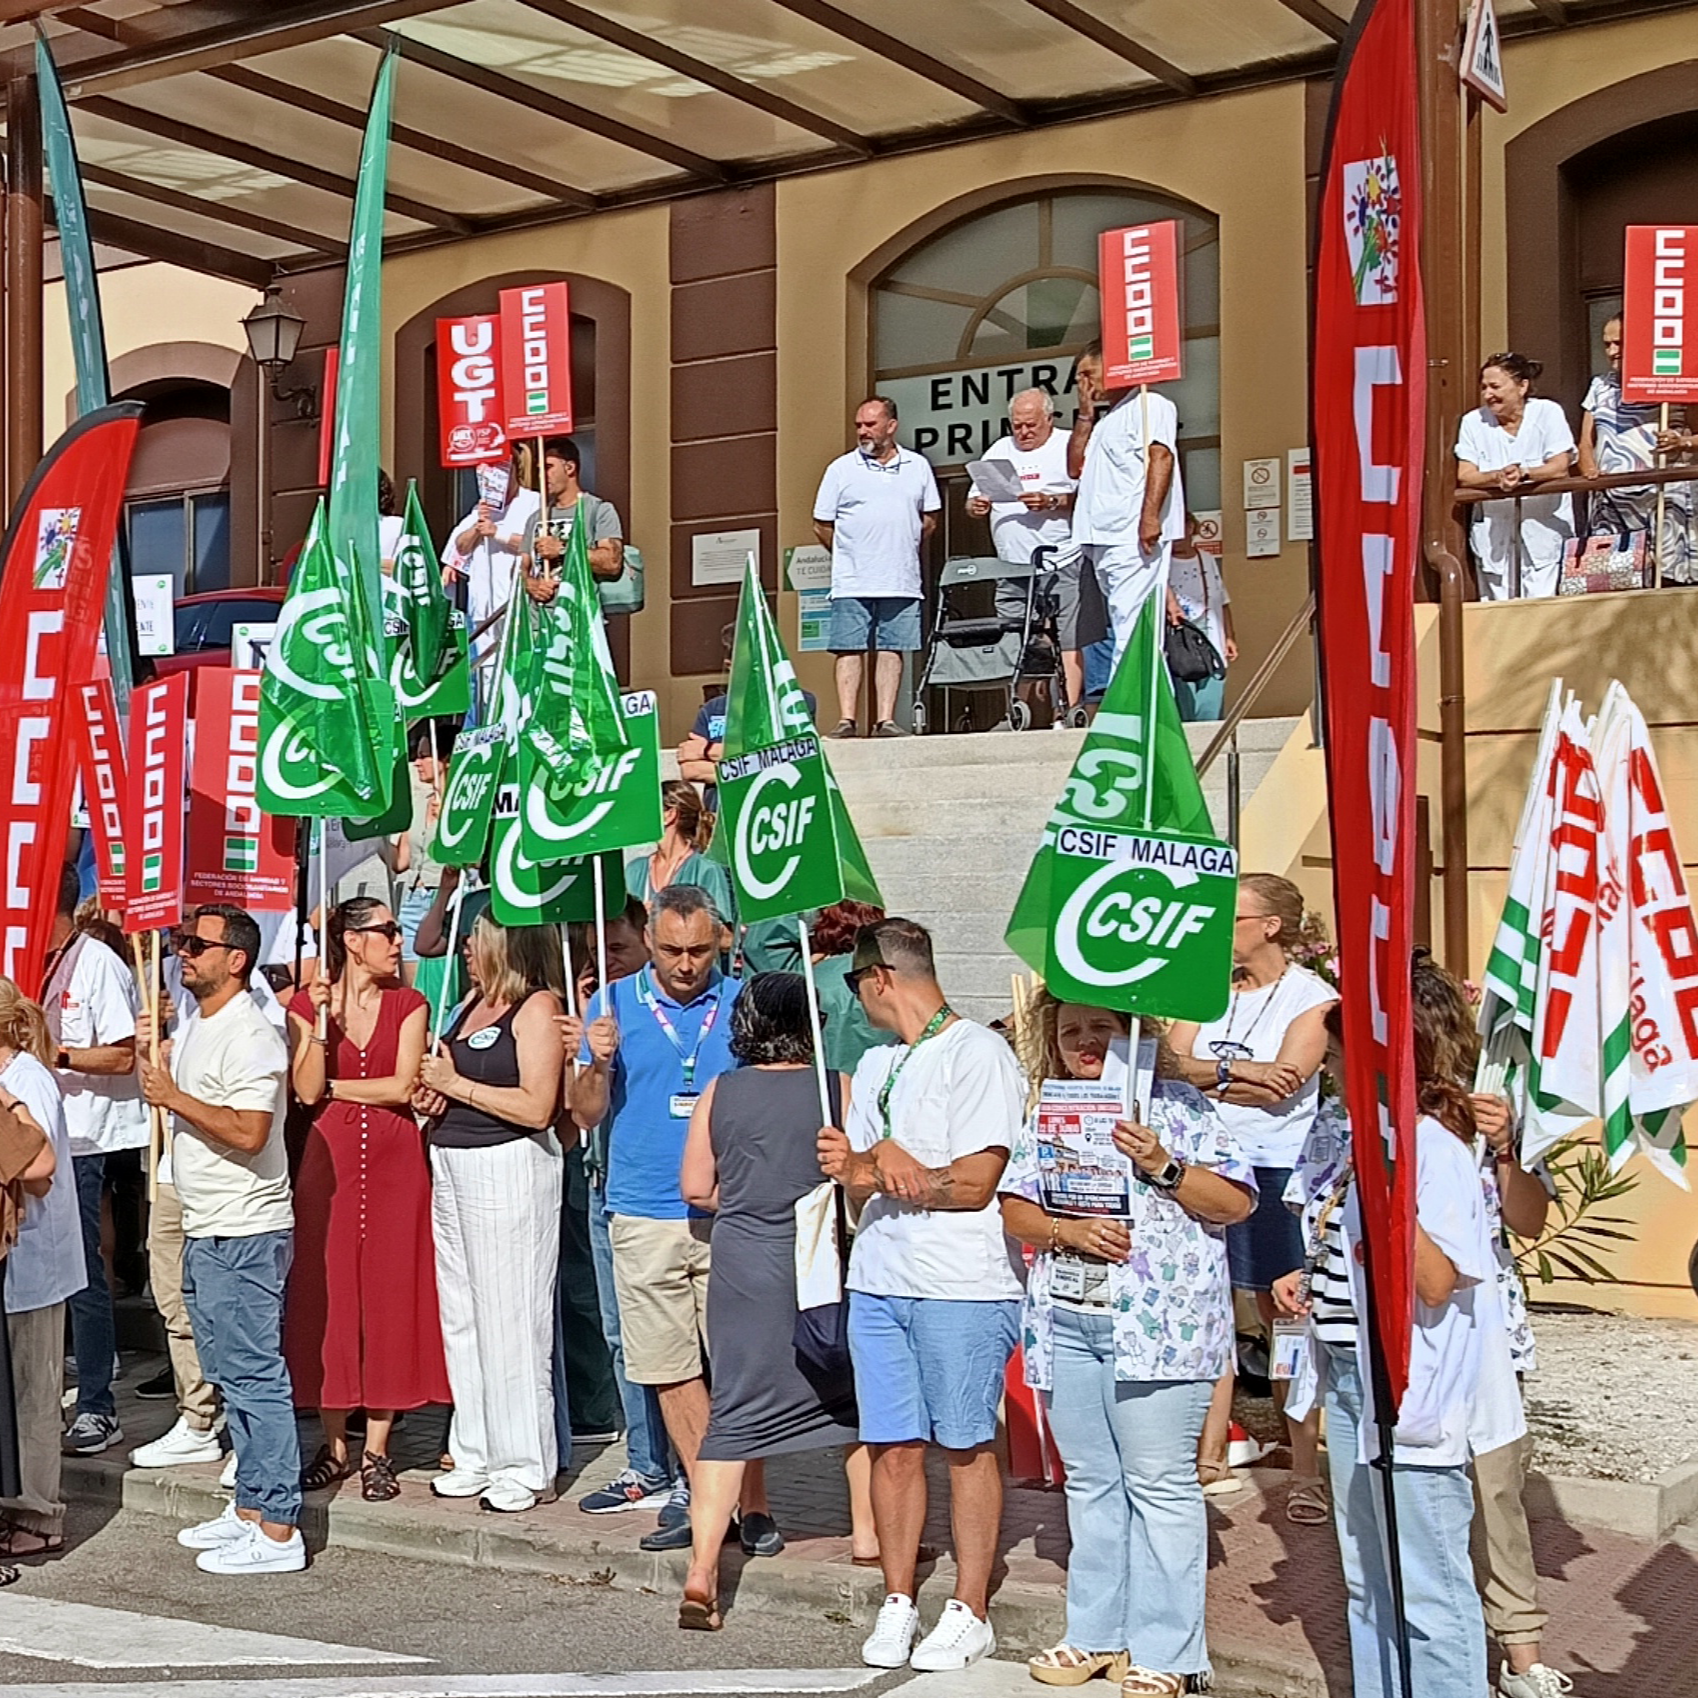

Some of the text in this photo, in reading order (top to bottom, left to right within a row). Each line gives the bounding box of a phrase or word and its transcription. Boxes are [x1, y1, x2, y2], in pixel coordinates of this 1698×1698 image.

[1124, 229, 1153, 335] CCOO
[1653, 230, 1685, 347] CCOO
[451, 322, 495, 423] UGT
[521, 288, 548, 390] CCOO
[82, 686, 123, 838] CCOO
[143, 684, 169, 851] CCOO
[452, 773, 493, 811] CSIF
[719, 737, 817, 781] CSIF MALAGA
[751, 795, 816, 855] CSIF
[1060, 829, 1235, 875] CSIF MALAGA
[1086, 891, 1216, 950] CSIF
